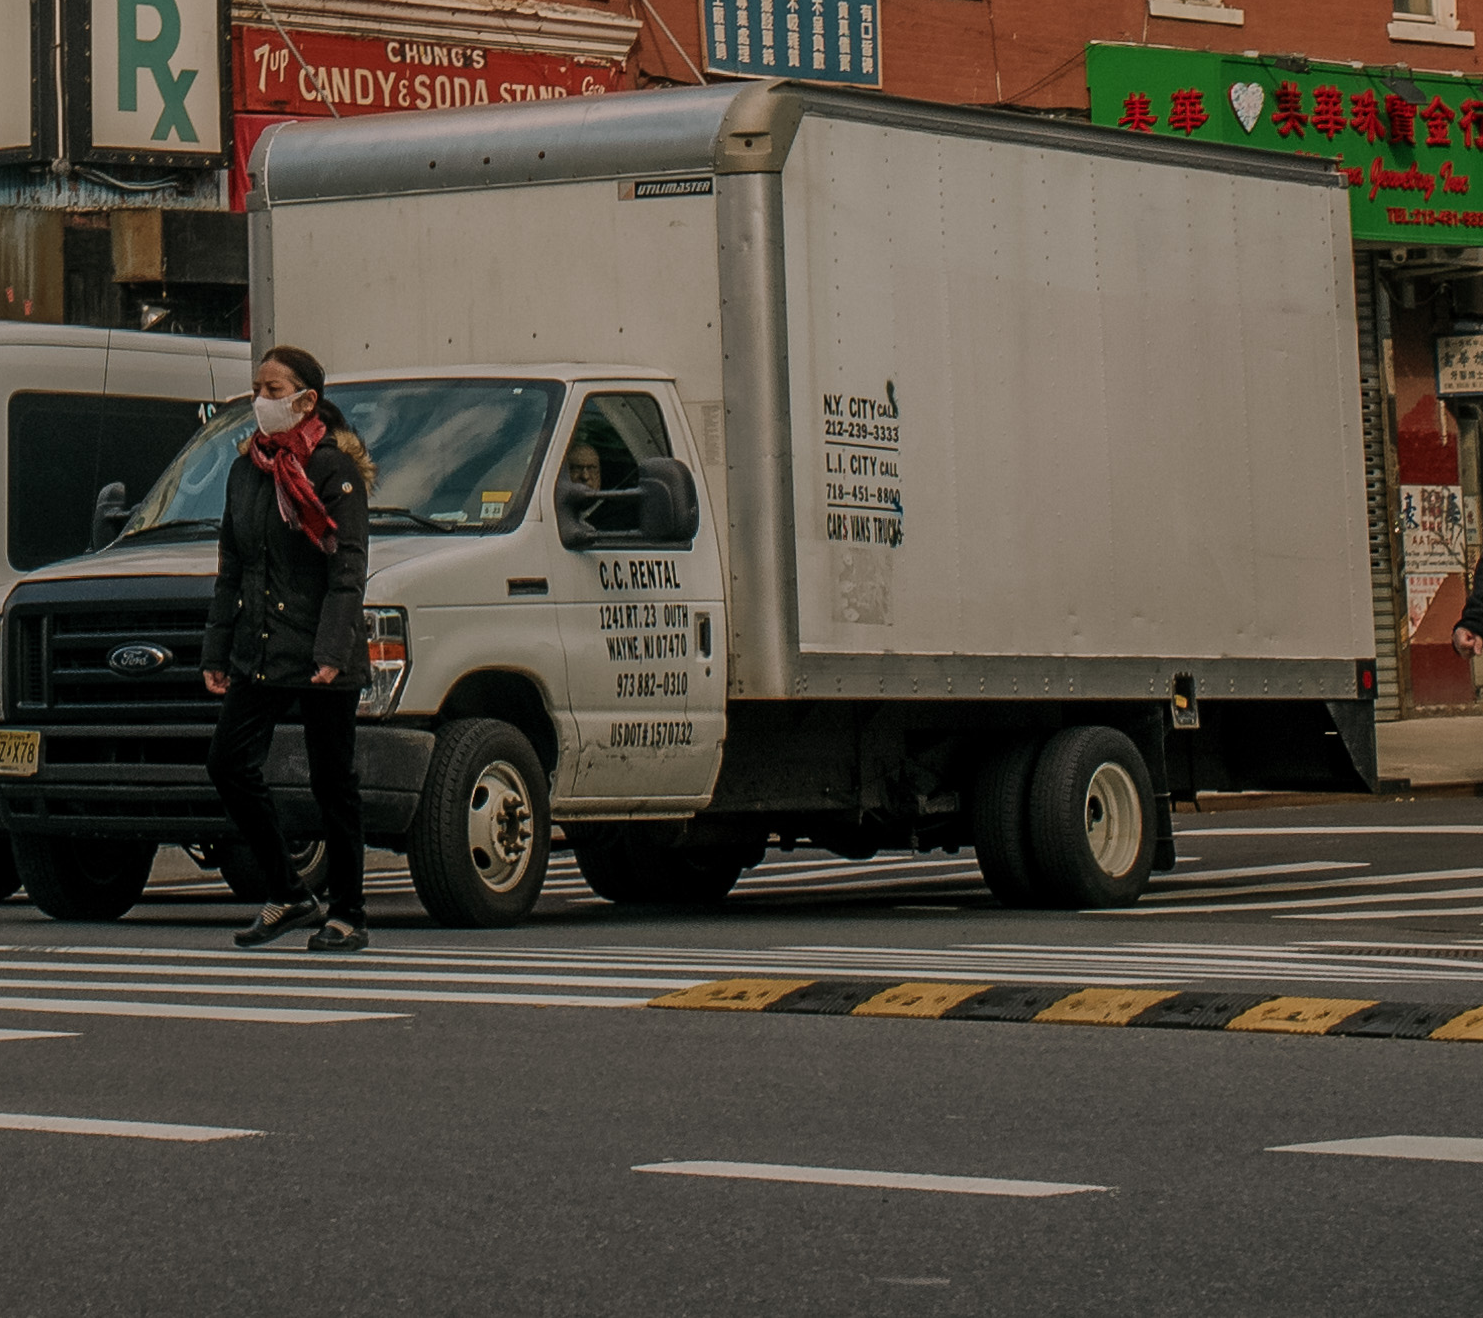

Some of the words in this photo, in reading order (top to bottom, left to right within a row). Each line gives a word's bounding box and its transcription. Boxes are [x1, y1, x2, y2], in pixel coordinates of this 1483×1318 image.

[386, 40, 485, 69] CHUNG'S
[298, 66, 397, 107] CANDY
[413, 73, 490, 110] SODA
[1118, 87, 1210, 136] 美華
[636, 180, 712, 196] UTILIMASTER
[823, 394, 844, 417] N.Y.
[848, 397, 877, 420] CITY
[877, 402, 899, 420] CALL
[825, 419, 900, 443] 212-239-3333
[825, 452, 846, 474] L.I.
[850, 454, 878, 477] CITY
[879, 461, 899, 478] CALL
[826, 483, 901, 505] 718-451-8800
[826, 513, 849, 541] CARS
[850, 514, 871, 543] VANS
[873, 516, 903, 548] TRUCKS
[599, 560, 629, 591] C.C.
[628, 560, 681, 590] RENTAL
[599, 605, 625, 630] 1241
[625, 604, 642, 629] RT.
[643, 604, 657, 629] 23
[663, 604, 689, 629] OUTH
[120, 649, 149, 667] Ford
[605, 636, 642, 664] WAYNE,
[643, 635, 655, 660] NJ
[656, 633, 688, 659] 07470
[616, 673, 635, 698] 973
[637, 671, 688, 698] 882-0310
[649, 721, 693, 747] 1570732
